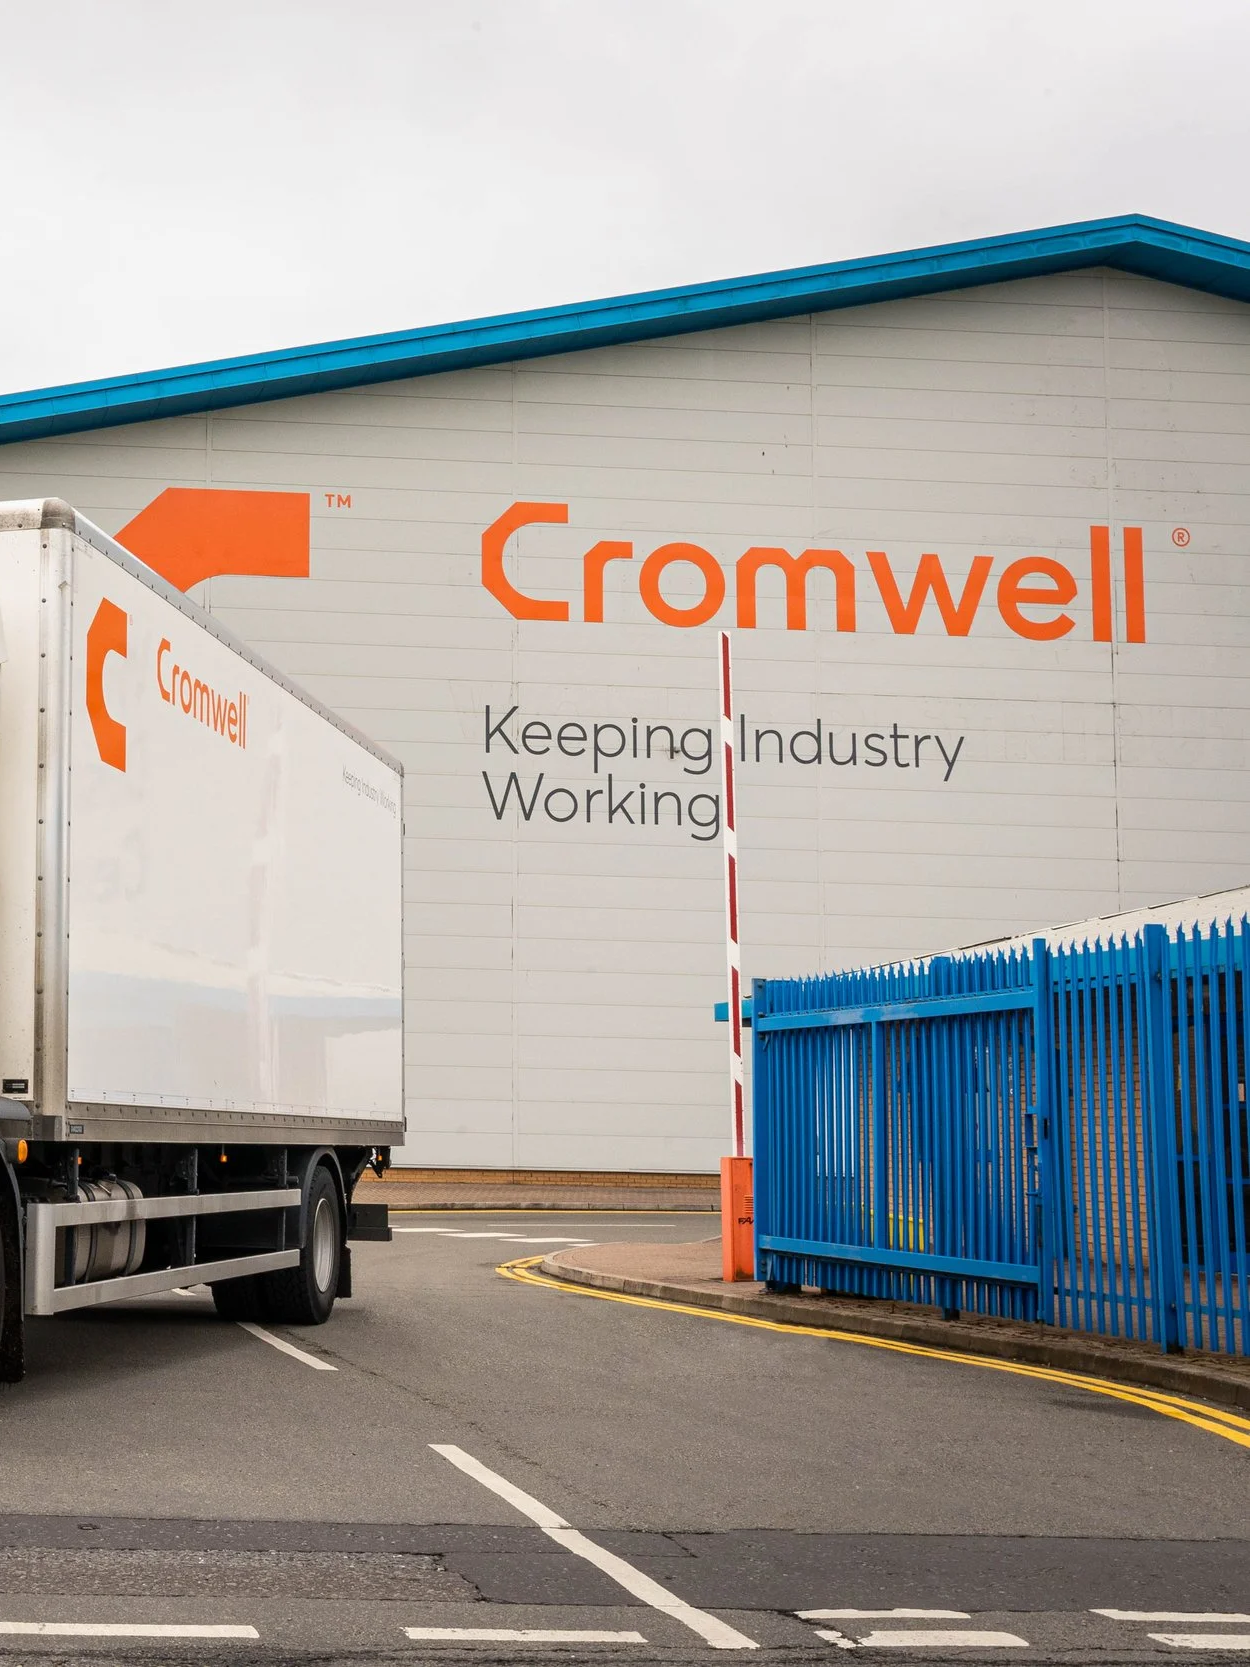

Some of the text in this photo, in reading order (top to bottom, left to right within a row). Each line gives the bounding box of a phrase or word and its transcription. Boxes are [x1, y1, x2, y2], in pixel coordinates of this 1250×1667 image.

[481, 501, 1146, 643] Cromwell
[157, 638, 247, 749] Cromwell
[483, 704, 965, 783] Keeping Industry
[481, 770, 721, 841] Working
[738, 1216, 754, 1225] FA
